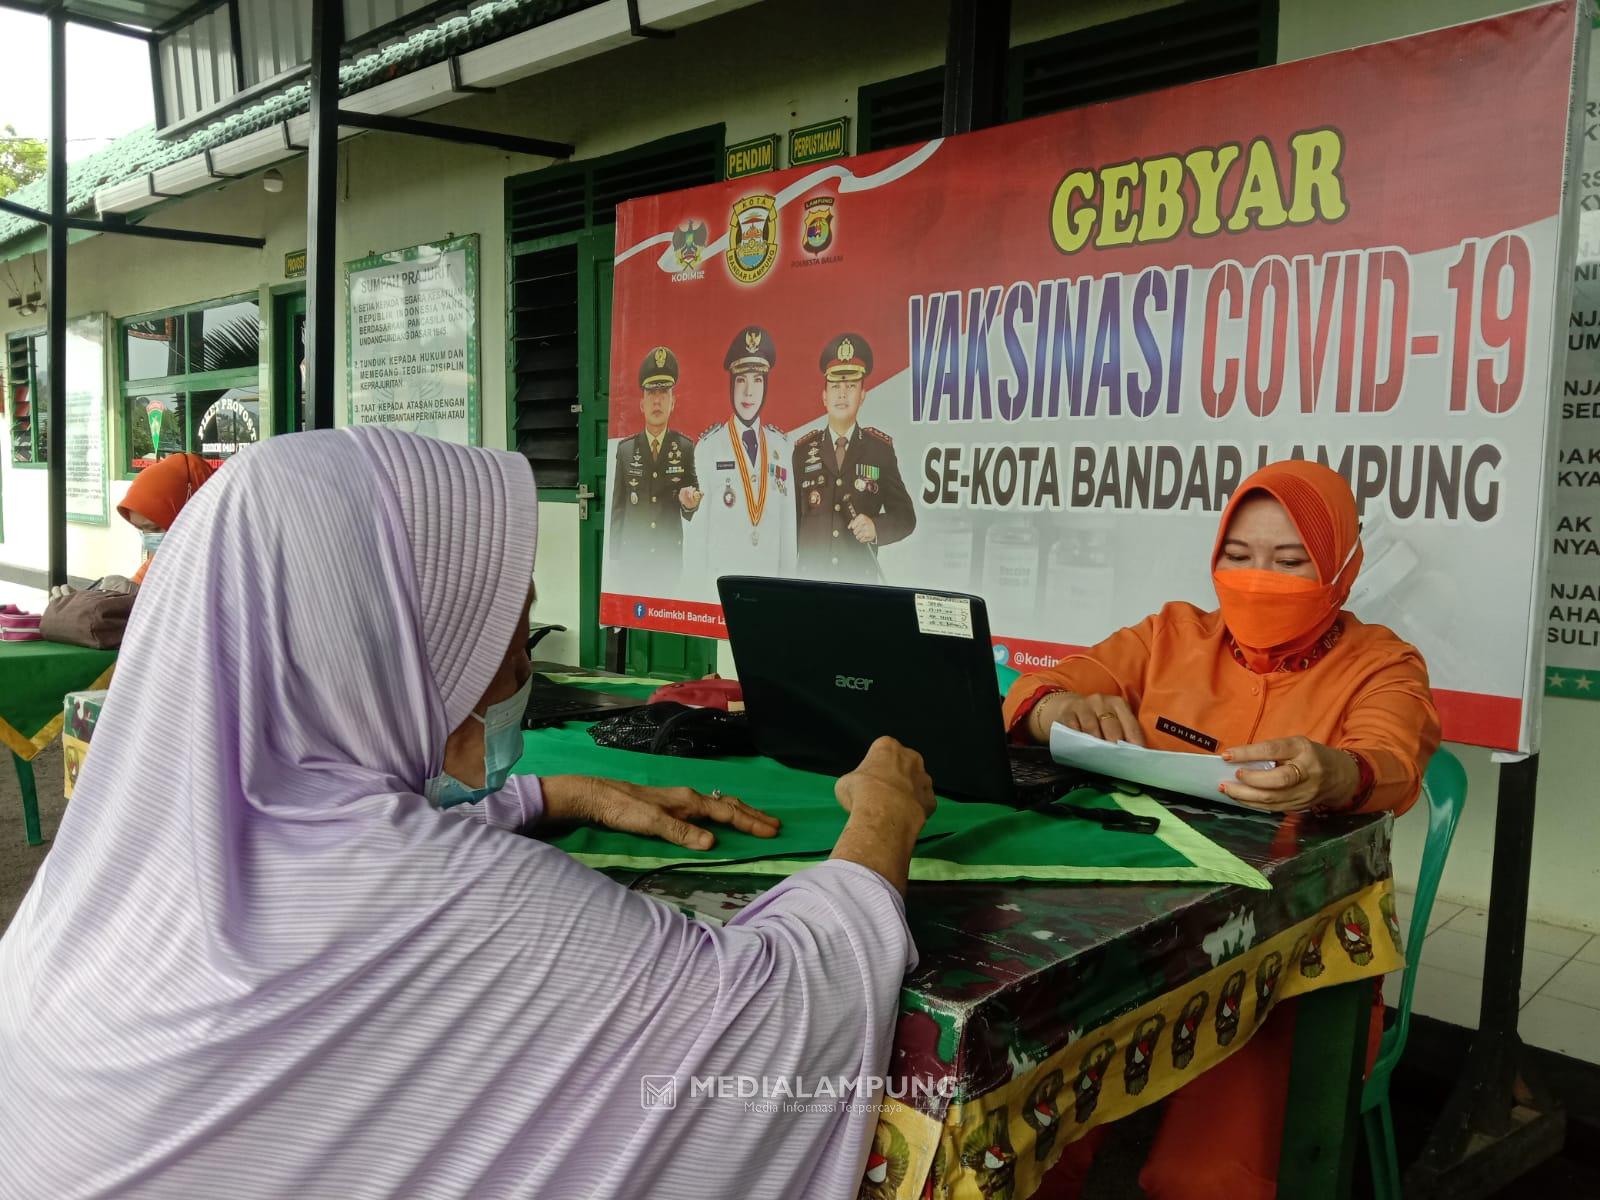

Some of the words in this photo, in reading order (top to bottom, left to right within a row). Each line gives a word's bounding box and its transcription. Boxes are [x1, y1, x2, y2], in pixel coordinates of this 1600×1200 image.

[794, 128, 841, 157] PERPUSTAKAAN
[729, 145, 771, 174] PENDIM
[1050, 128, 1348, 254] GEBYAR
[742, 199, 766, 208] KOTA
[910, 267, 1191, 422] VAKSINASI
[1199, 233, 1532, 419] COVID-19
[360, 358, 386, 368] TUNDUK
[389, 355, 416, 365] KEPADA
[420, 351, 446, 361] HUKUM
[448, 349, 464, 359] DAN
[431, 361, 464, 373] DISIPLIN
[378, 402, 403, 412] KEPADA
[434, 398, 465, 408] DENGAN
[448, 409, 465, 419] ATAU
[923, 446, 1060, 506] SE-KOTA
[1071, 445, 1242, 512] BANDAR
[1258, 444, 1502, 522] PUNG
[687, 612, 715, 624] Bandar
[835, 675, 874, 690] acer
